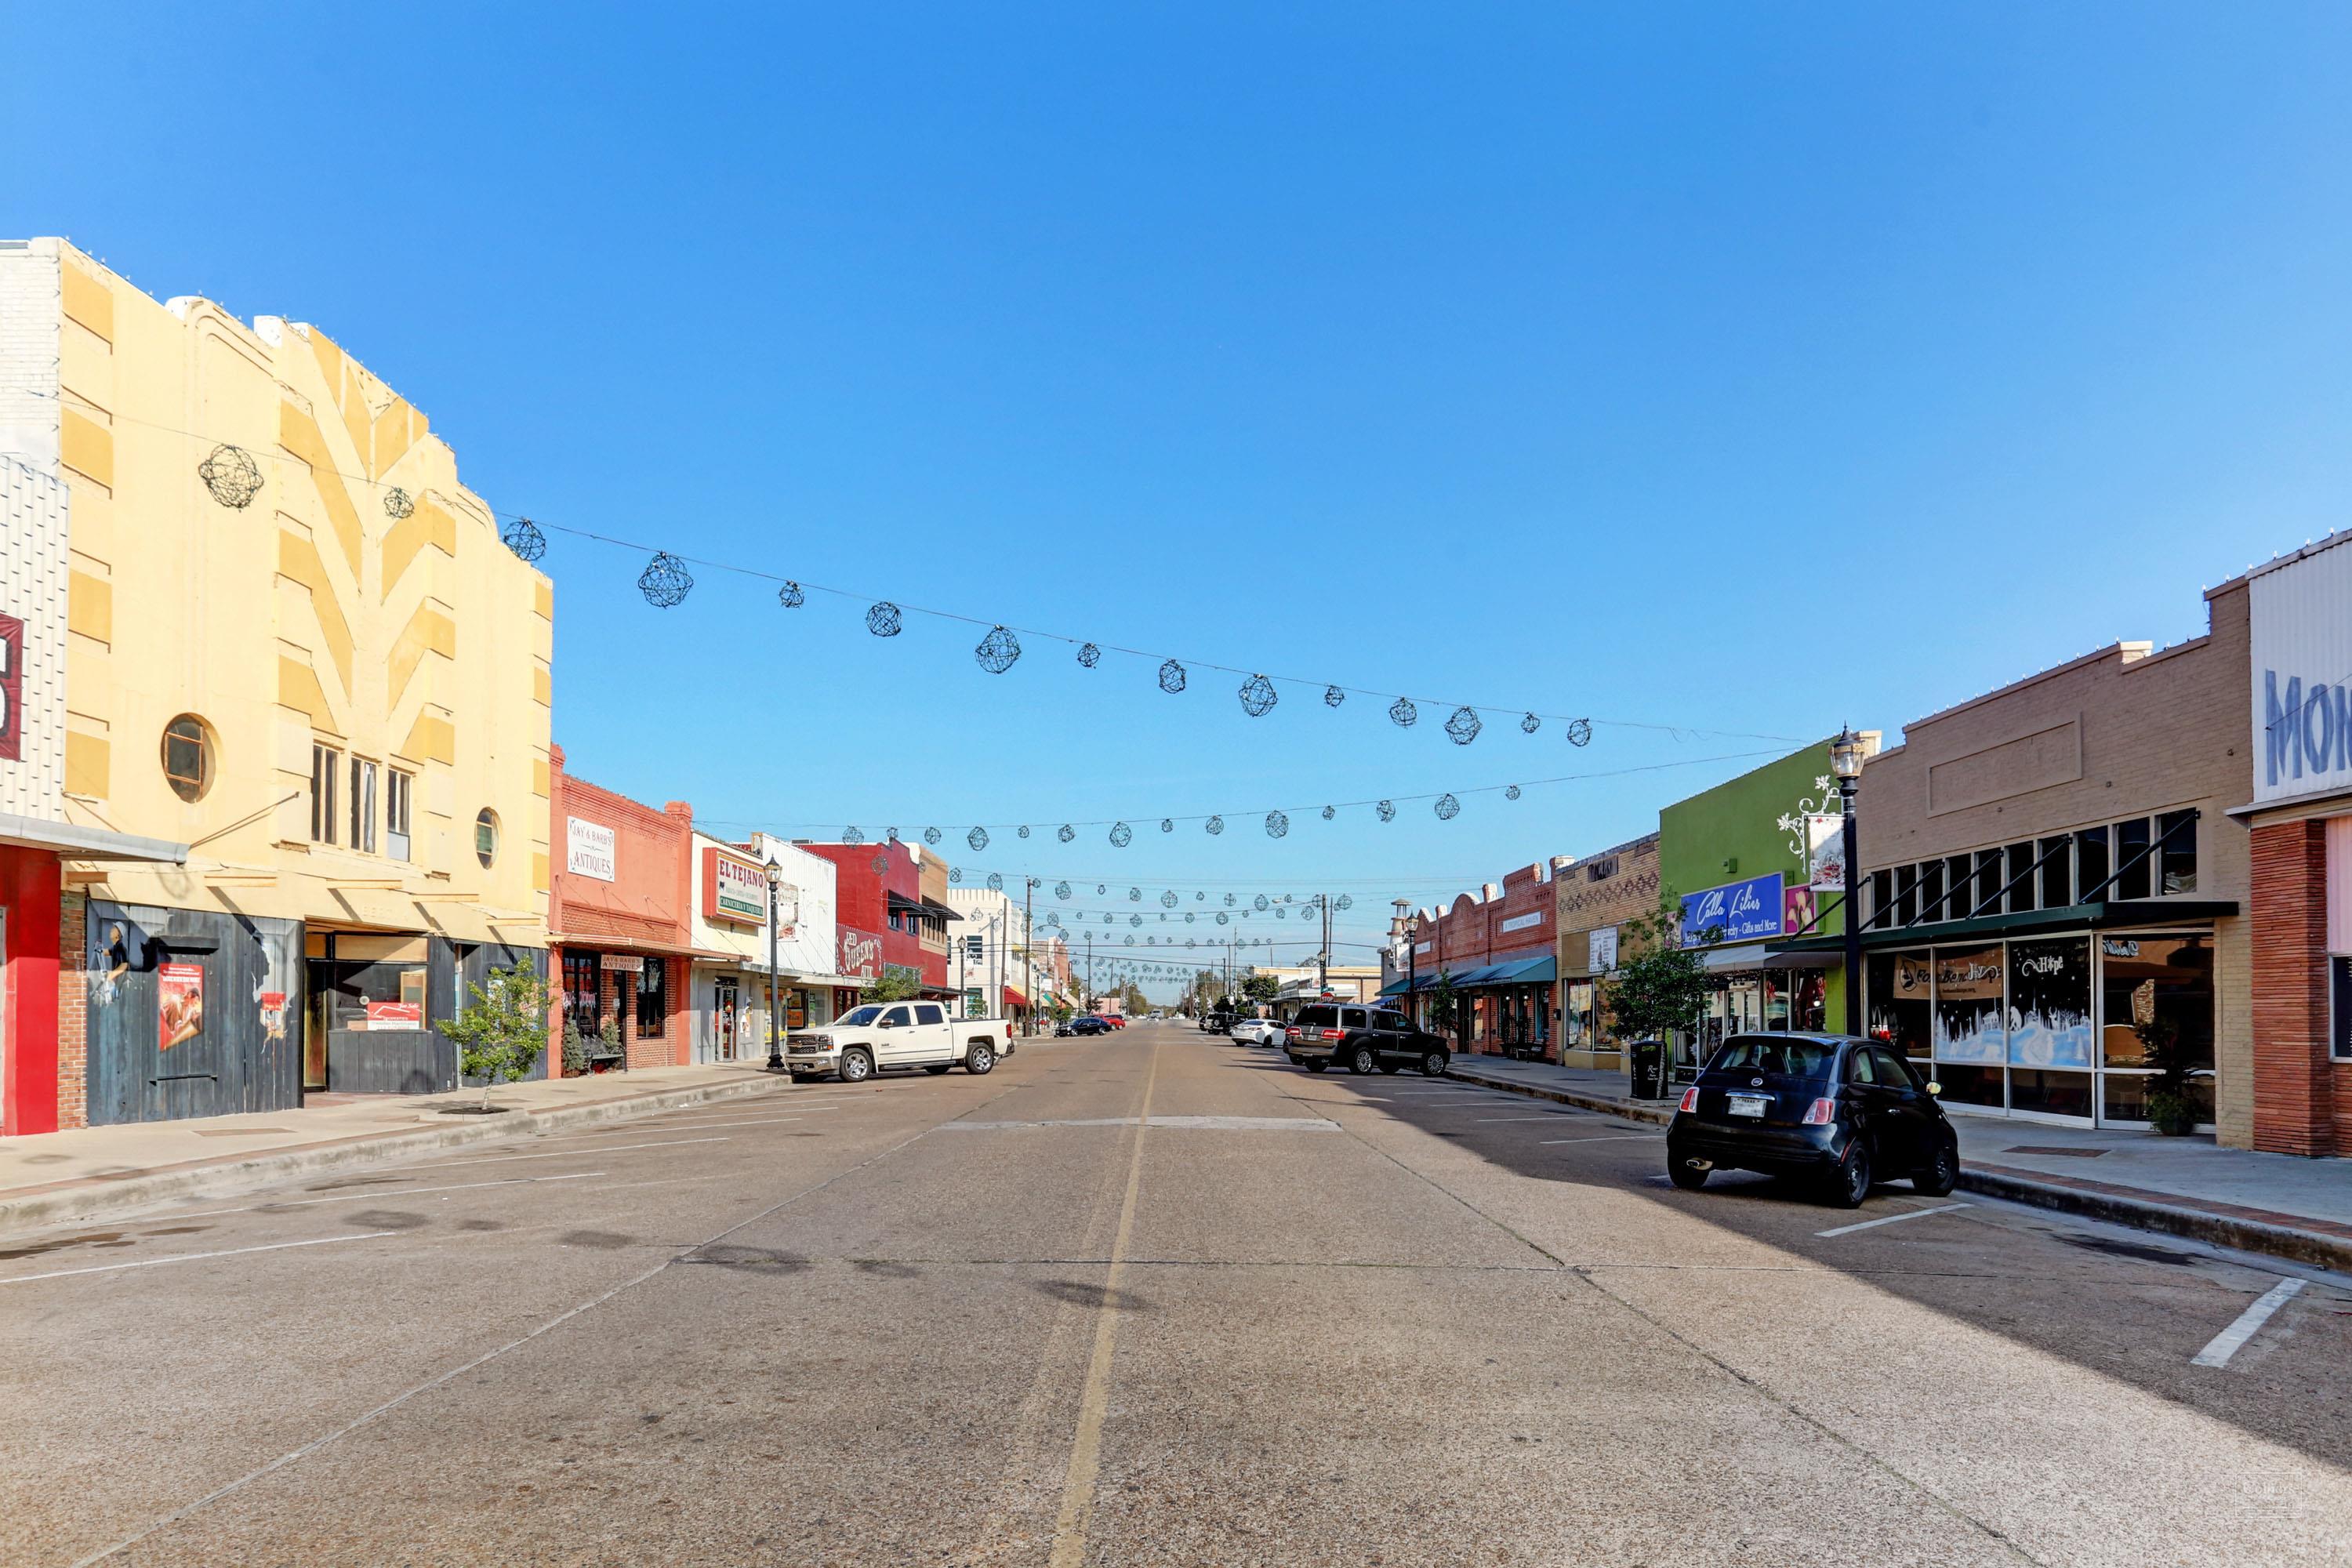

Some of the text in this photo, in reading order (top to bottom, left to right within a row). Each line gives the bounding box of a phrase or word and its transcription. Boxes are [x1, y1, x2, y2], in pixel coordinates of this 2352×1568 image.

[573, 851, 611, 874] ANTIQUES
[719, 859, 764, 888] EL TEJANO
[1697, 884, 1760, 925] Calla Lilies
[1765, 919, 1777, 931] More
[847, 931, 857, 946] RED
